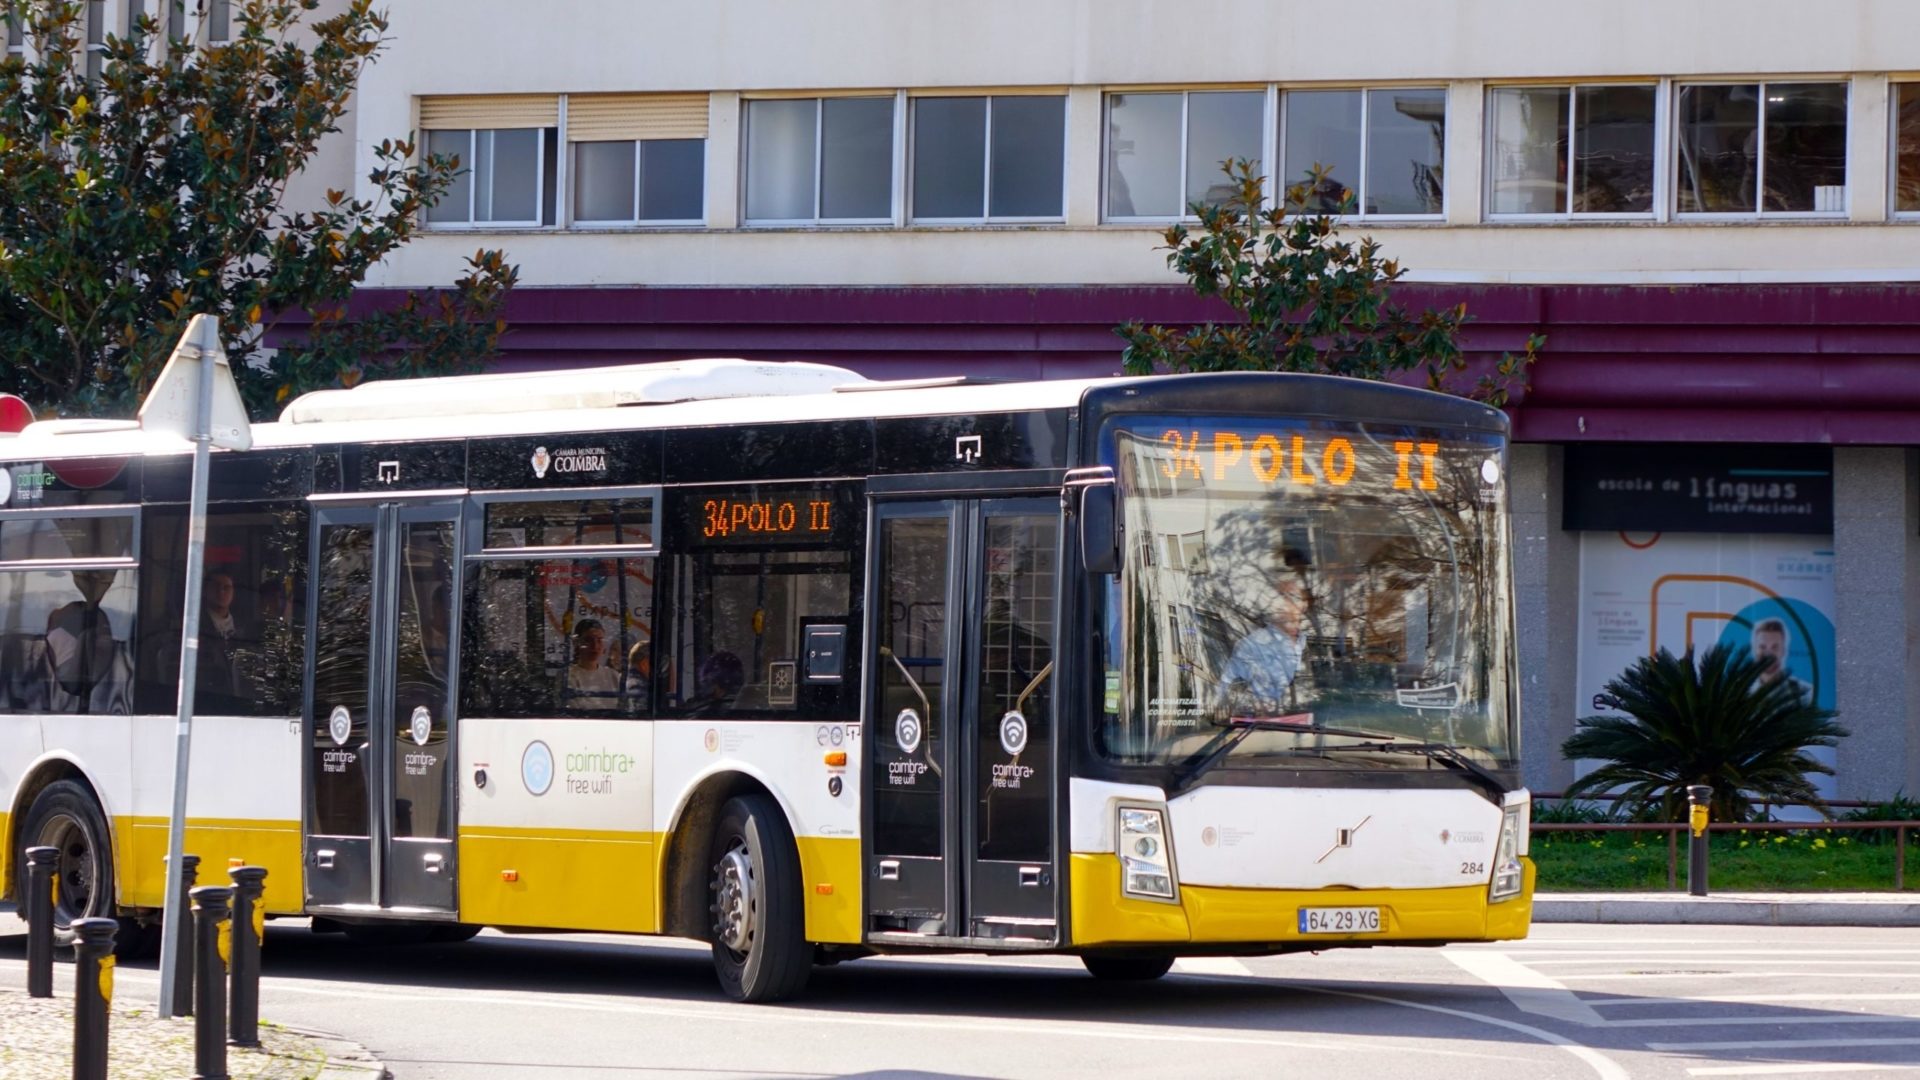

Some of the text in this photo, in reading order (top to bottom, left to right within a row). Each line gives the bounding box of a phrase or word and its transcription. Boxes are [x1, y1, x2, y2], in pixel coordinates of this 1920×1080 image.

[578, 447, 606, 456] MUNICIPAL
[554, 455, 606, 473] COIMBRA
[1161, 429, 1439, 490] 34 POLO II
[1598, 477, 1797, 502] escola de línguas
[1707, 501, 1812, 514] internacional
[703, 500, 831, 537] 34 POLO II
[323, 762, 346, 773] free wifi
[405, 765, 427, 775] free wifi
[566, 775, 612, 794] free wifi
[889, 773, 915, 785] free wifi
[992, 777, 1020, 789] free wifi
[1461, 862, 1484, 875] 284
